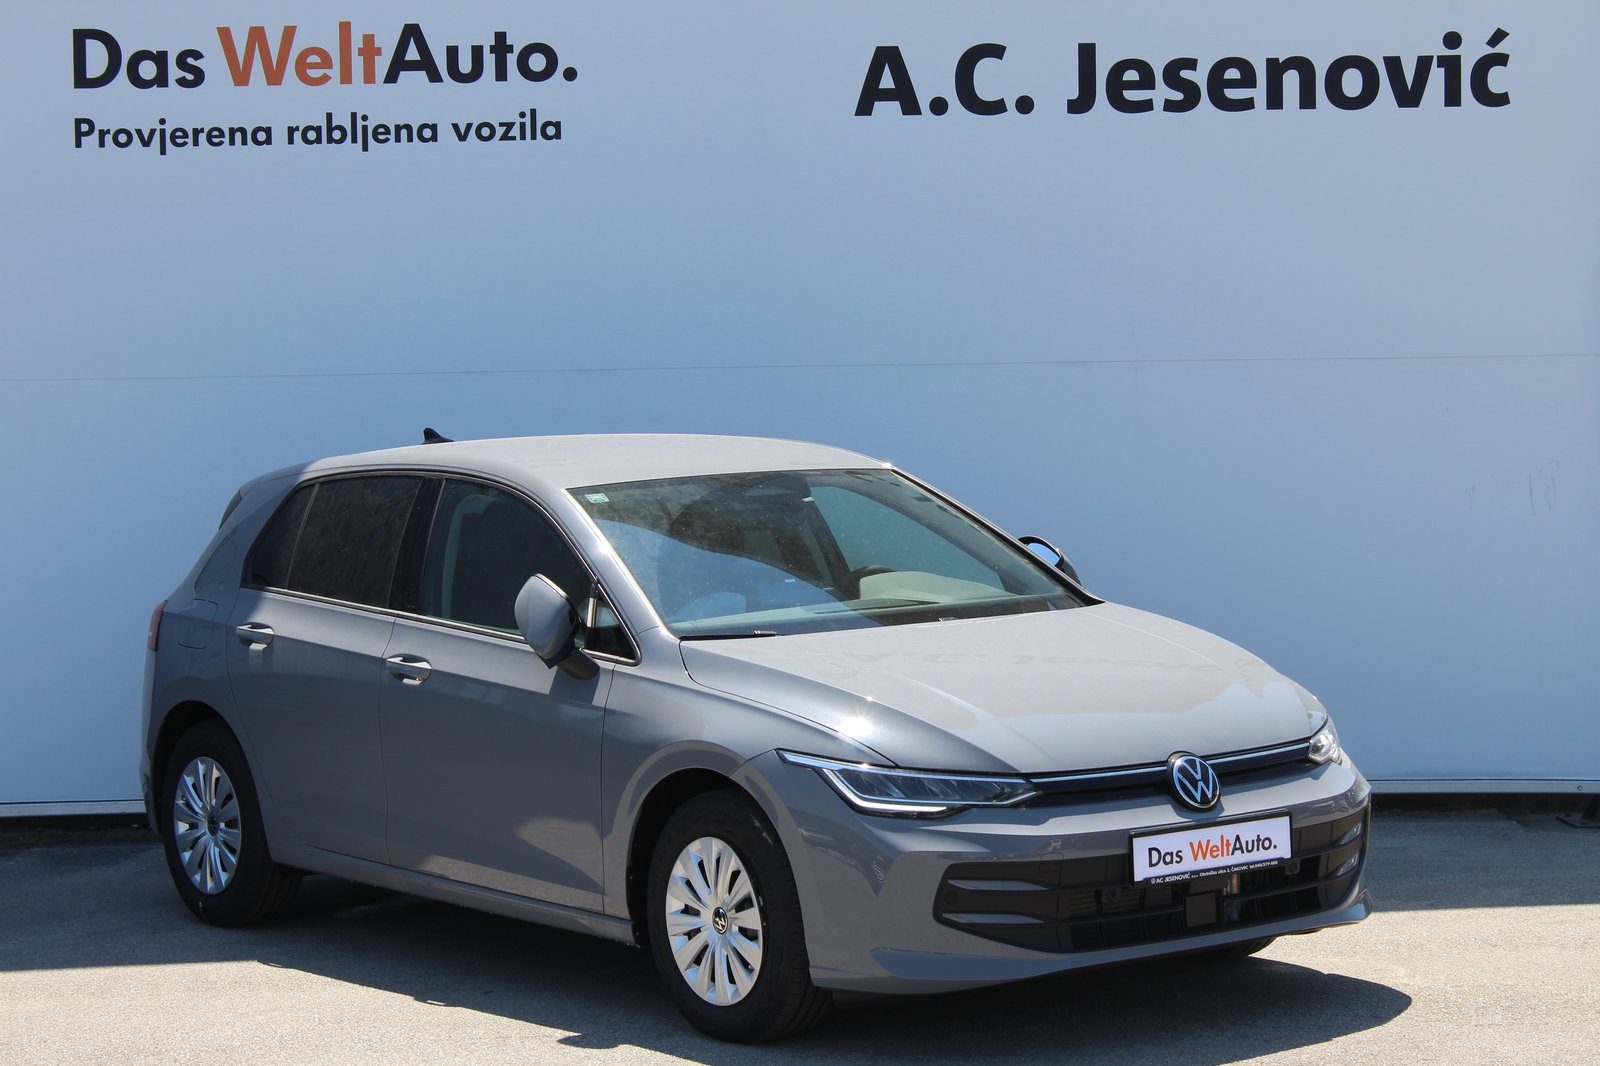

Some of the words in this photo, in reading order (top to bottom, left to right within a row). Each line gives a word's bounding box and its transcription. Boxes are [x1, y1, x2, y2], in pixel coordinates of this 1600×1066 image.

[73, 29, 205, 89] Das
[216, 21, 578, 86] WeltAuto.
[854, 43, 1034, 116] A.C.
[1067, 27, 1510, 114] Jesenović
[74, 118, 272, 155] Provjerena
[287, 112, 438, 152] rabljena
[451, 108, 561, 142] vozila
[1148, 846, 1183, 868] Das
[1189, 834, 1278, 862] WeltAuto.
